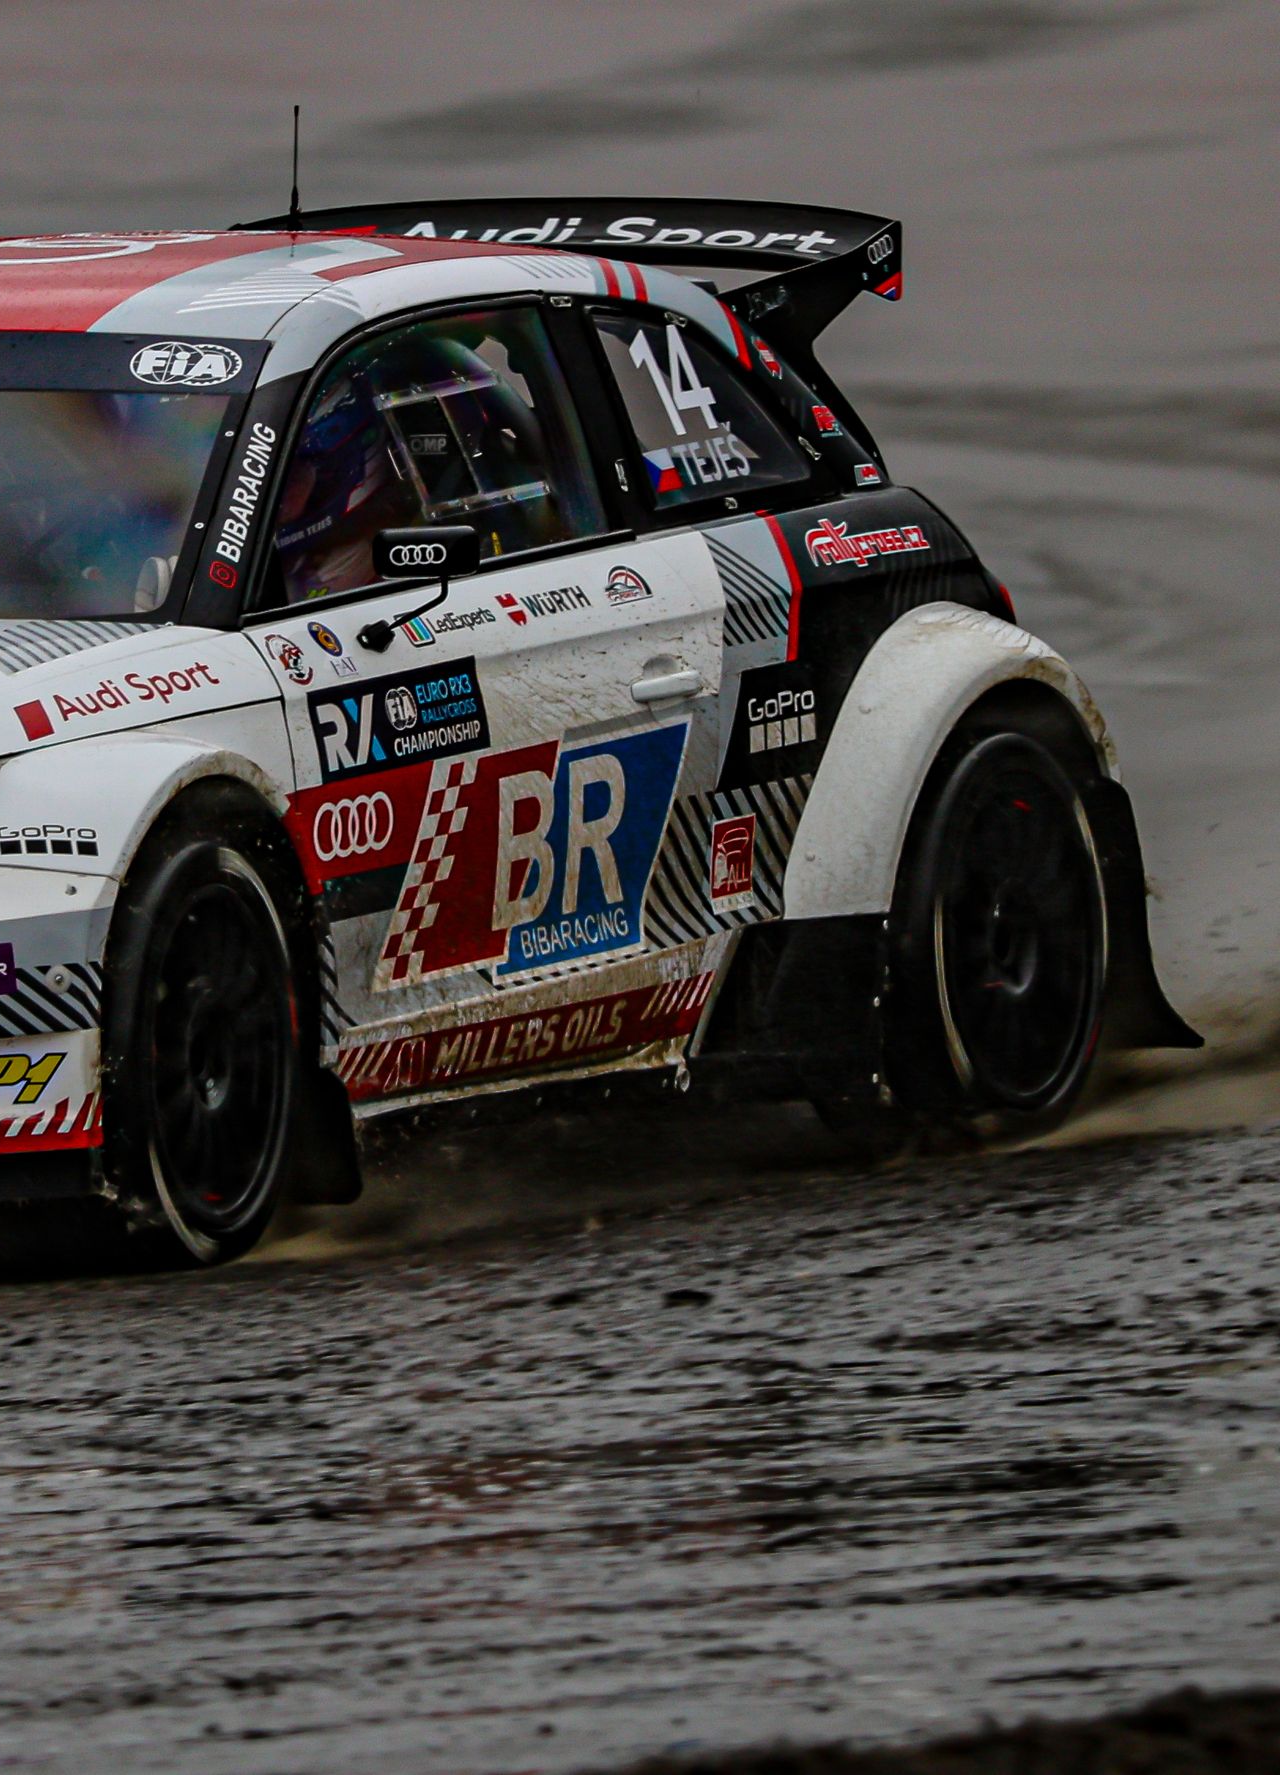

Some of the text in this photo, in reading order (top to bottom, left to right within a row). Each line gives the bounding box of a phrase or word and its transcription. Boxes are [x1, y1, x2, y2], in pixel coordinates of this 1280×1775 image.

[594, 216, 839, 255] Sport
[629, 324, 717, 436] 14
[672, 421, 751, 485] TEJEŠ
[216, 422, 277, 563] BIBARACING
[426, 607, 496, 634] LedExperts
[53, 662, 220, 721] Audi Sport
[415, 674, 472, 704] EURO RX3
[421, 698, 477, 724] RALLYCROSS
[748, 690, 815, 722] GoPro
[316, 693, 387, 772] RX
[394, 720, 481, 757] CHAMPIONSHIP
[492, 753, 626, 931] BR
[521, 908, 629, 960] BIBARACING
[432, 1001, 629, 1078] MILLERS OILS
